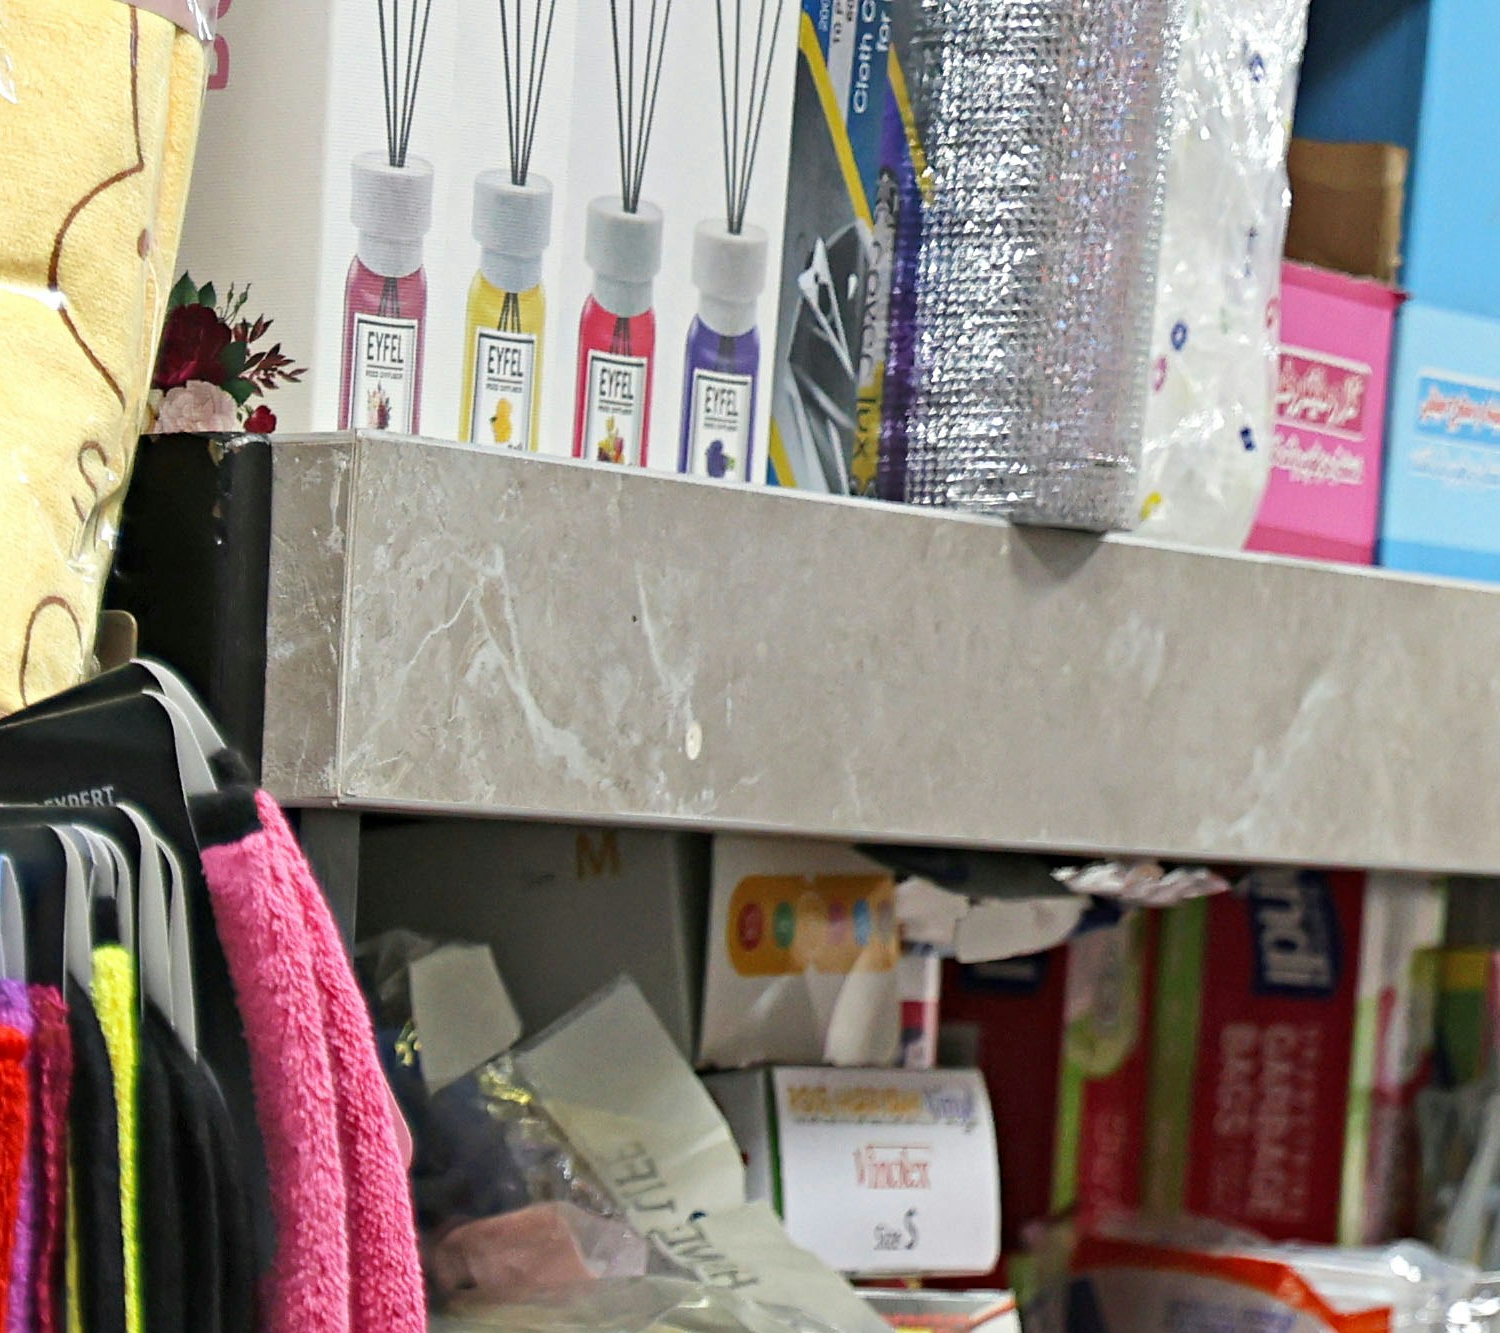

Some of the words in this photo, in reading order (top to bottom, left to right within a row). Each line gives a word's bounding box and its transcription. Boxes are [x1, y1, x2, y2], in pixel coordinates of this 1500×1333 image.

[366, 331, 404, 364] EYFEL
[488, 345, 524, 378] EYFEL
[599, 368, 635, 400] EYFEL
[704, 387, 739, 418] EYFEL
